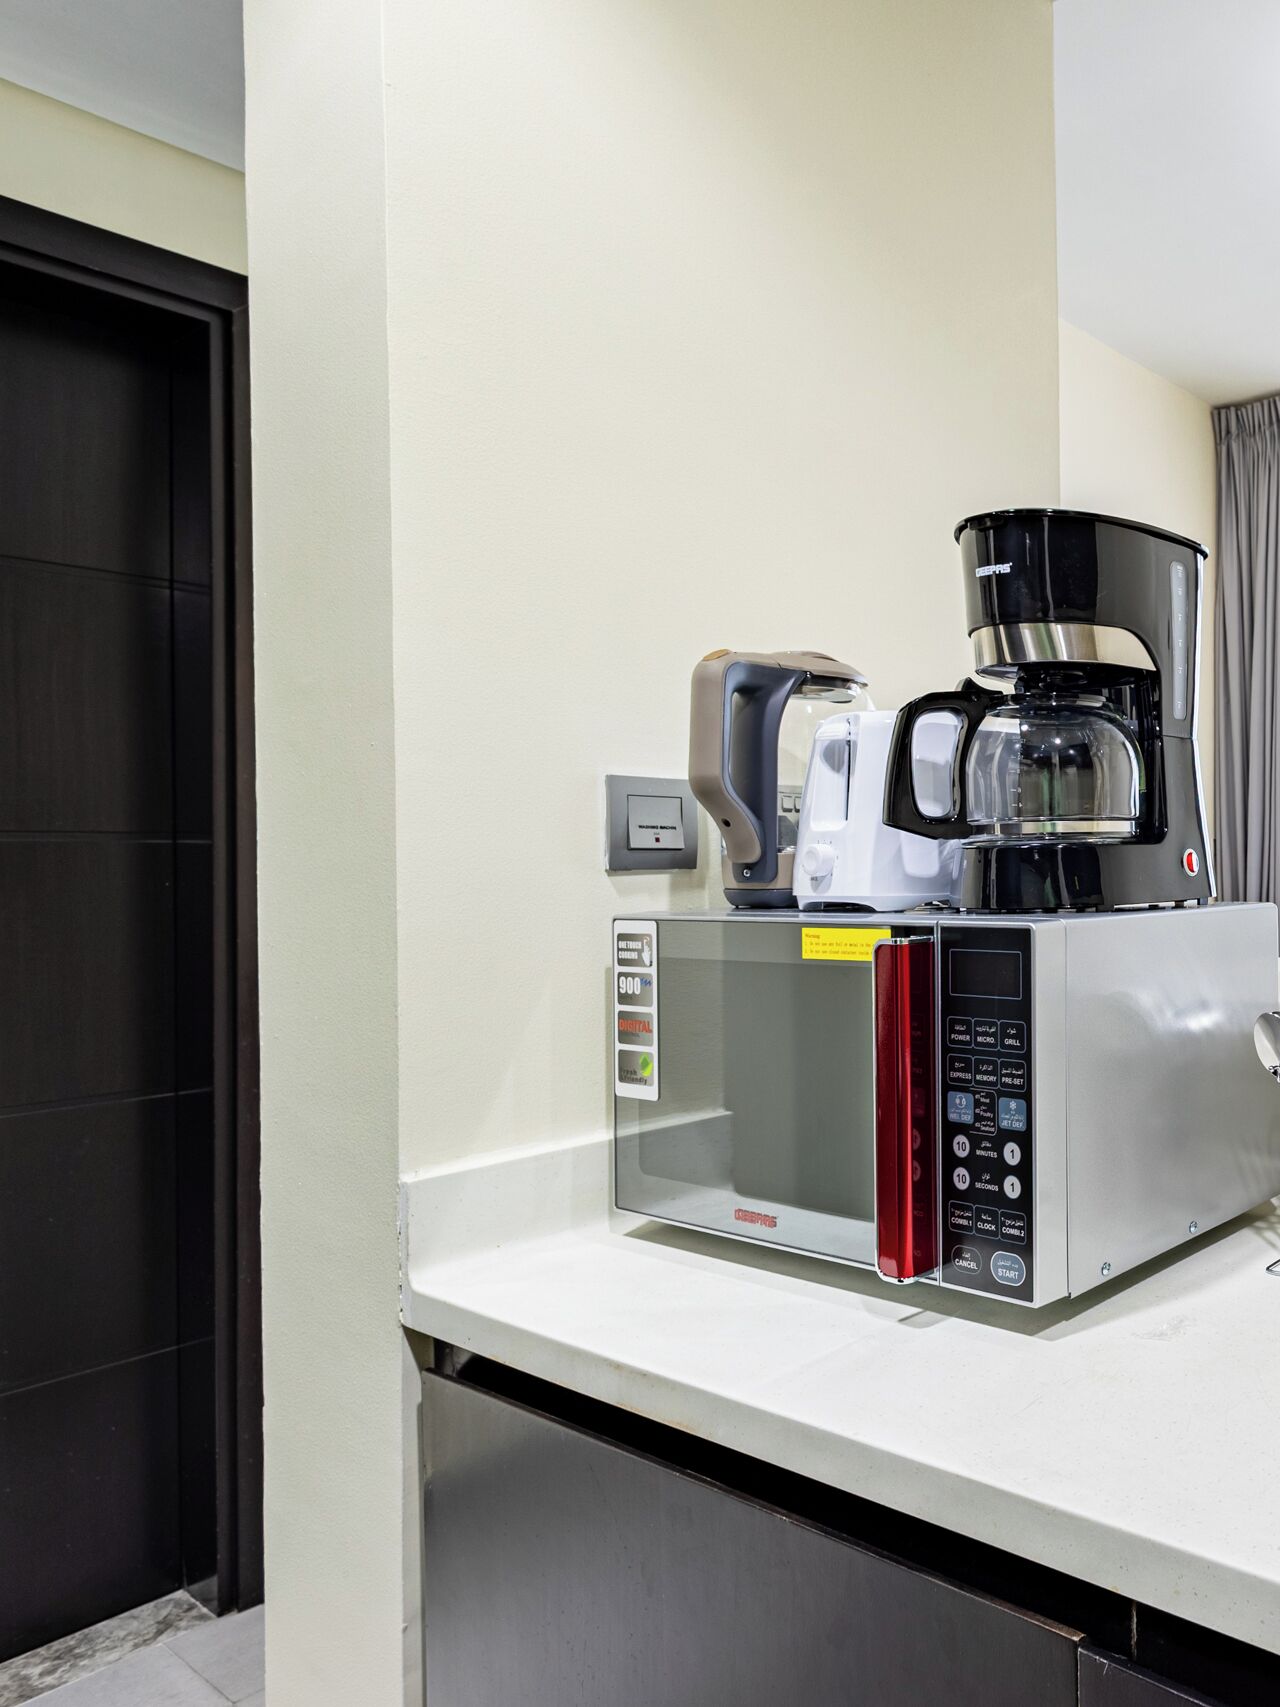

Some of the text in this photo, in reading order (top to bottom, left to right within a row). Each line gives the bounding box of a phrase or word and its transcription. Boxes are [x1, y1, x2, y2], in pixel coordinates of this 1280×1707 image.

[619, 976, 641, 995] 900
[618, 1018, 652, 1034] DIGITAL
[951, 1034, 970, 1042] POWER
[1004, 1038, 1020, 1046] GRILL
[950, 1072, 972, 1080] EXPRESS
[1002, 1077, 1024, 1085] PRE-SET
[956, 1141, 966, 1152] 10
[976, 1149, 998, 1158] MINUTES
[1009, 1149, 1015, 1160] 1
[956, 1173, 966, 1184] 10
[975, 1182, 999, 1192] SECONDS
[1009, 1182, 1015, 1192] 1
[977, 1222, 996, 1231] CLOCK
[955, 1258, 978, 1270] CANCEL
[998, 1269, 1019, 1279] START
